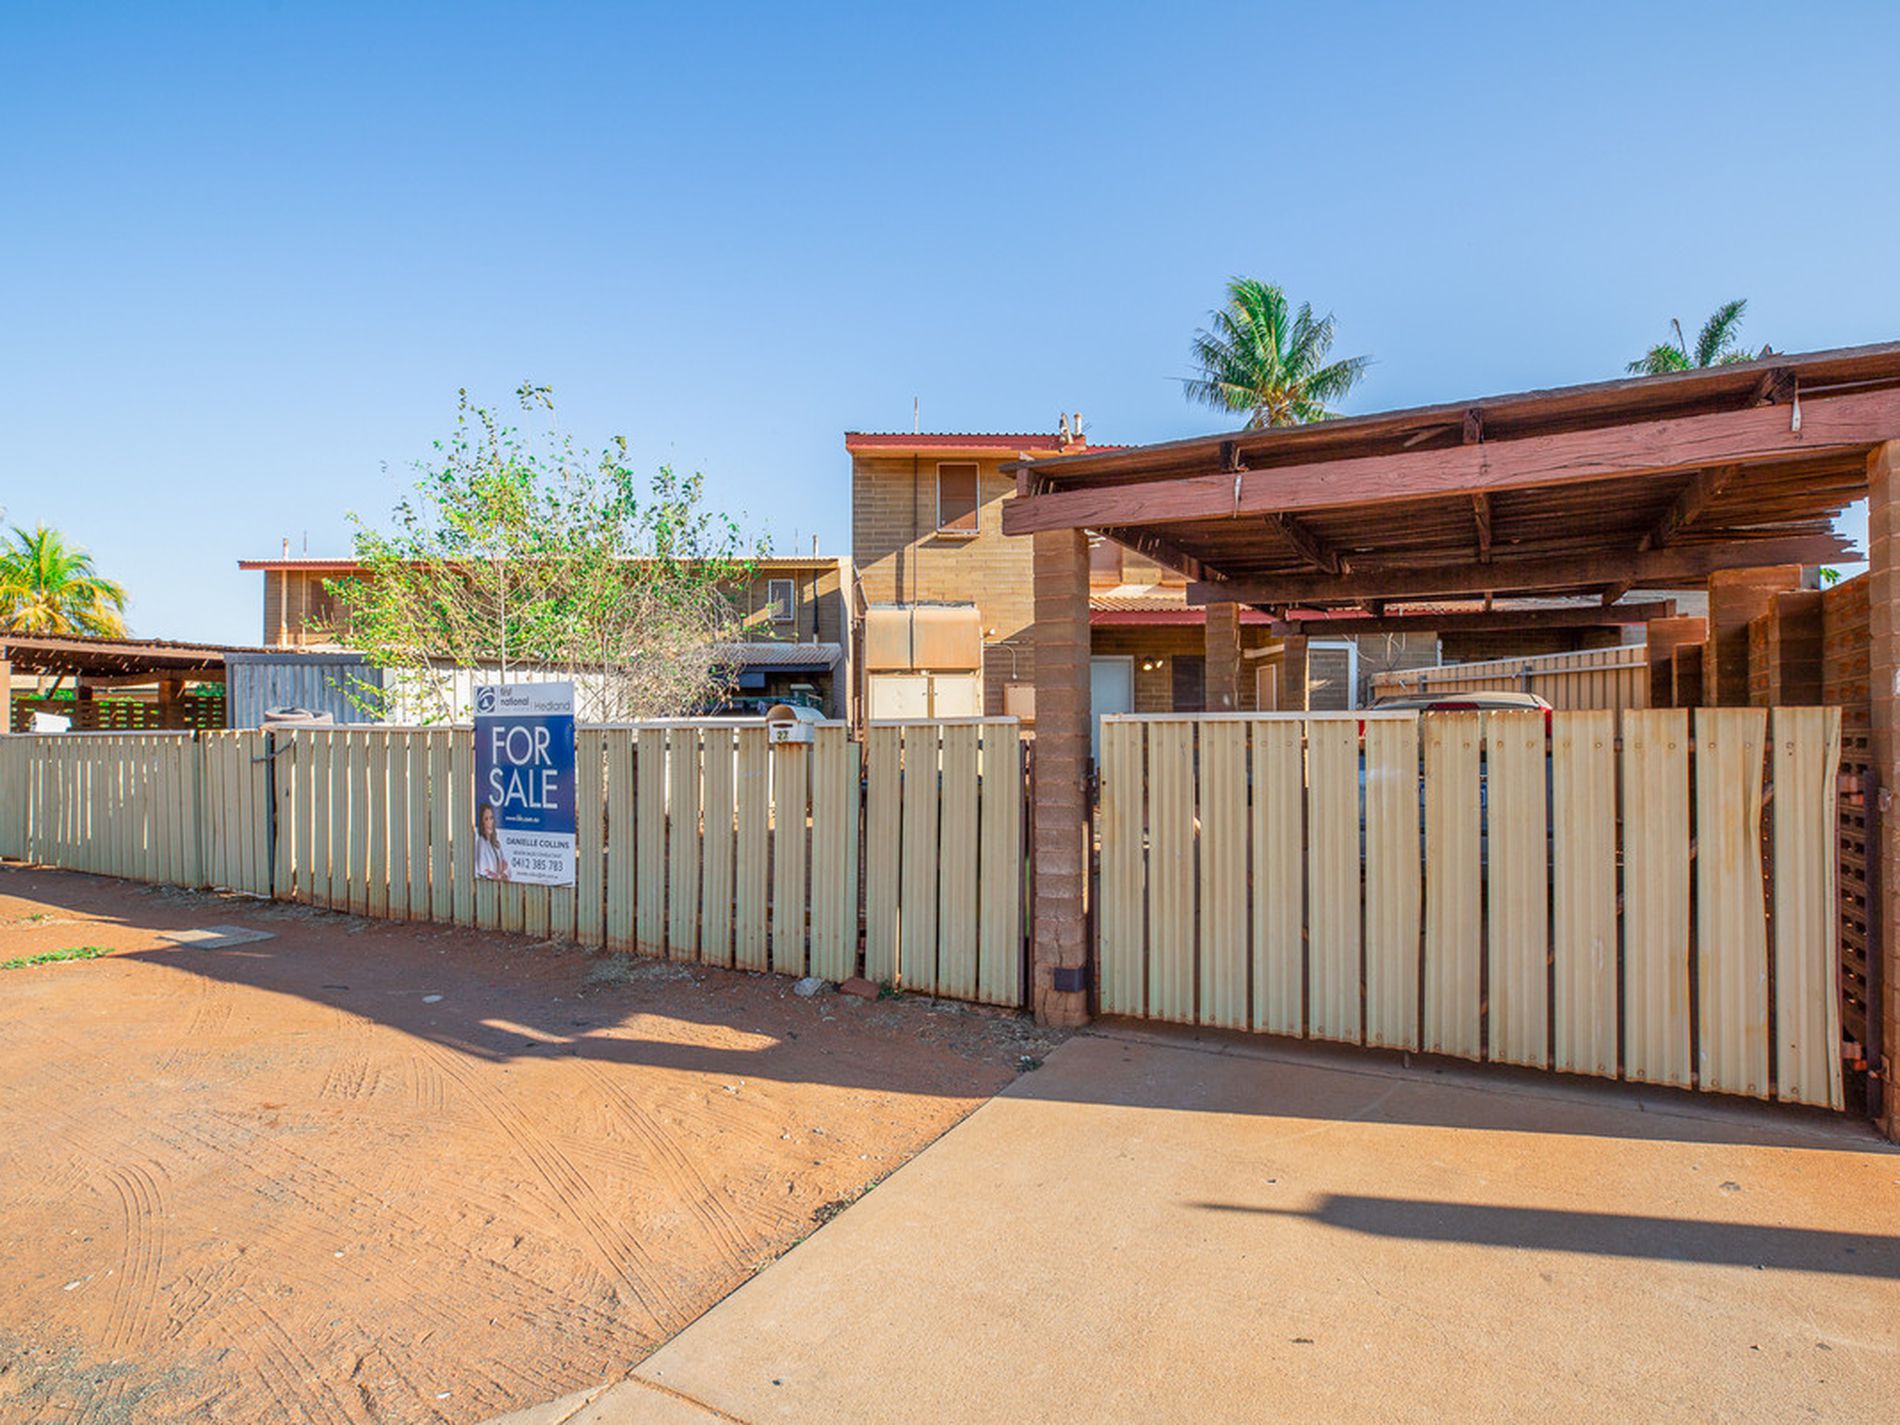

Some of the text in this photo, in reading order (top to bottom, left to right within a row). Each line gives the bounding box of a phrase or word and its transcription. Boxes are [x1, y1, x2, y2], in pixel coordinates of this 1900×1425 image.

[500, 696, 529, 706] national
[534, 701, 570, 711] Hedland
[492, 726, 552, 766] FOR
[489, 768, 558, 809] SALE
[506, 837, 570, 849] DANIELLE COLLINS
[511, 857, 564, 872] 0412 385 783
